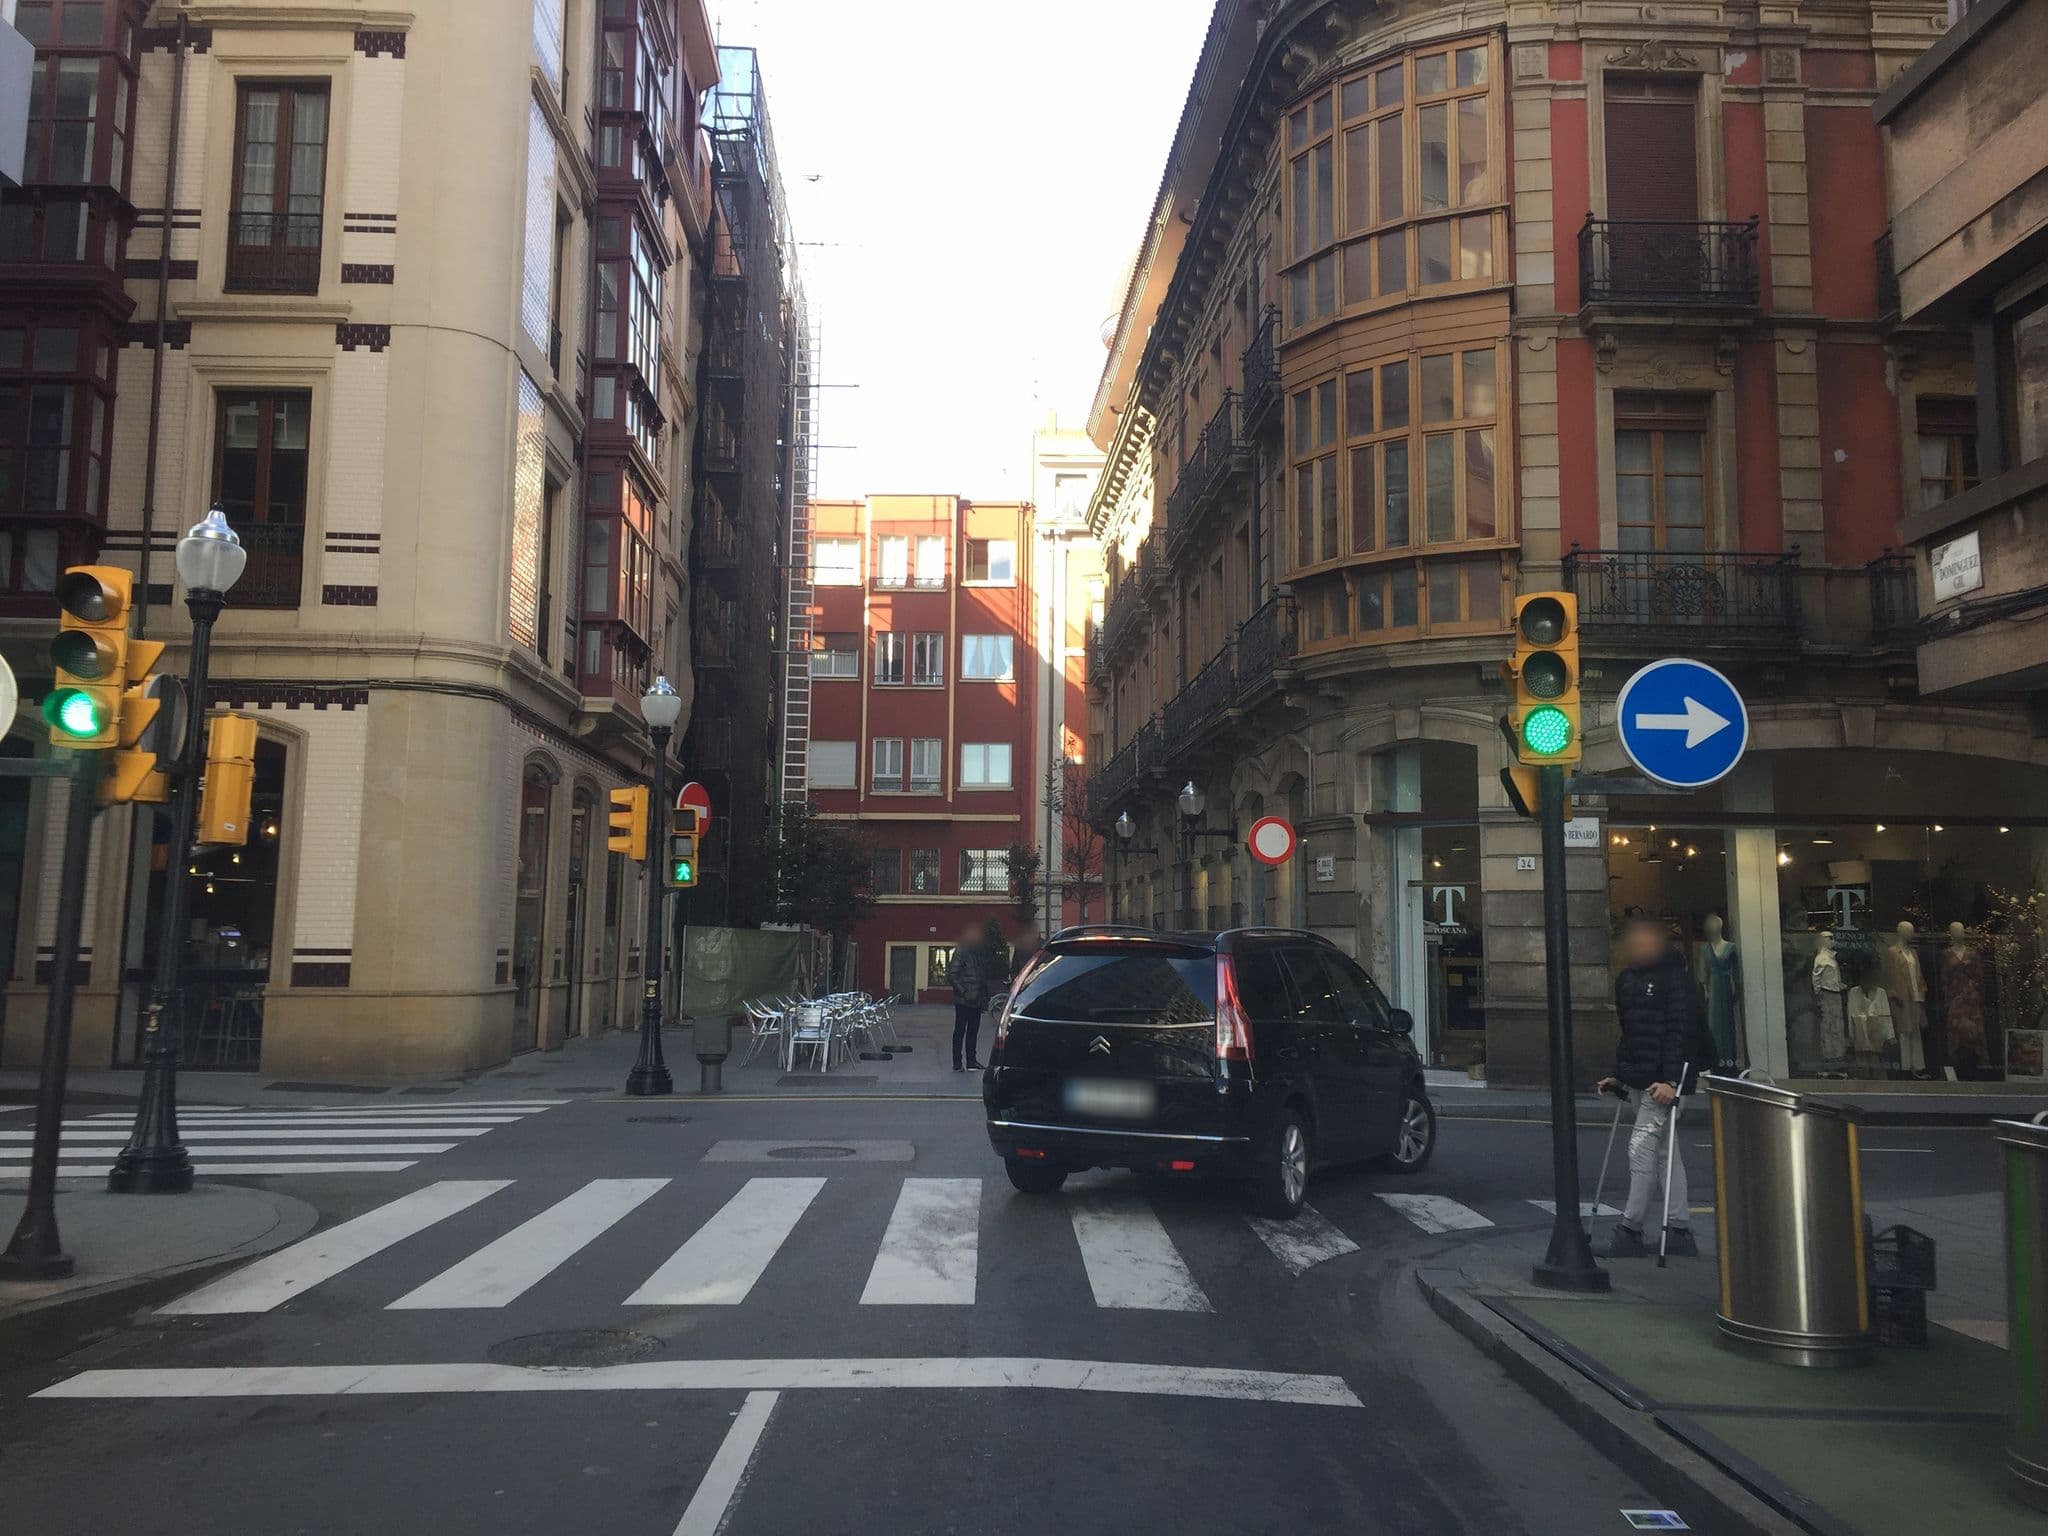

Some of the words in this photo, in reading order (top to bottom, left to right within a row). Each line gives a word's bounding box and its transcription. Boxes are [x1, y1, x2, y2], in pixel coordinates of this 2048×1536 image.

[1568, 830, 1598, 840] BERNARDO
[1520, 858, 1532, 869] 34
[1432, 886, 1466, 927] T
[1827, 888, 1865, 931] T
[1432, 927, 1468, 935] TOSCANA
